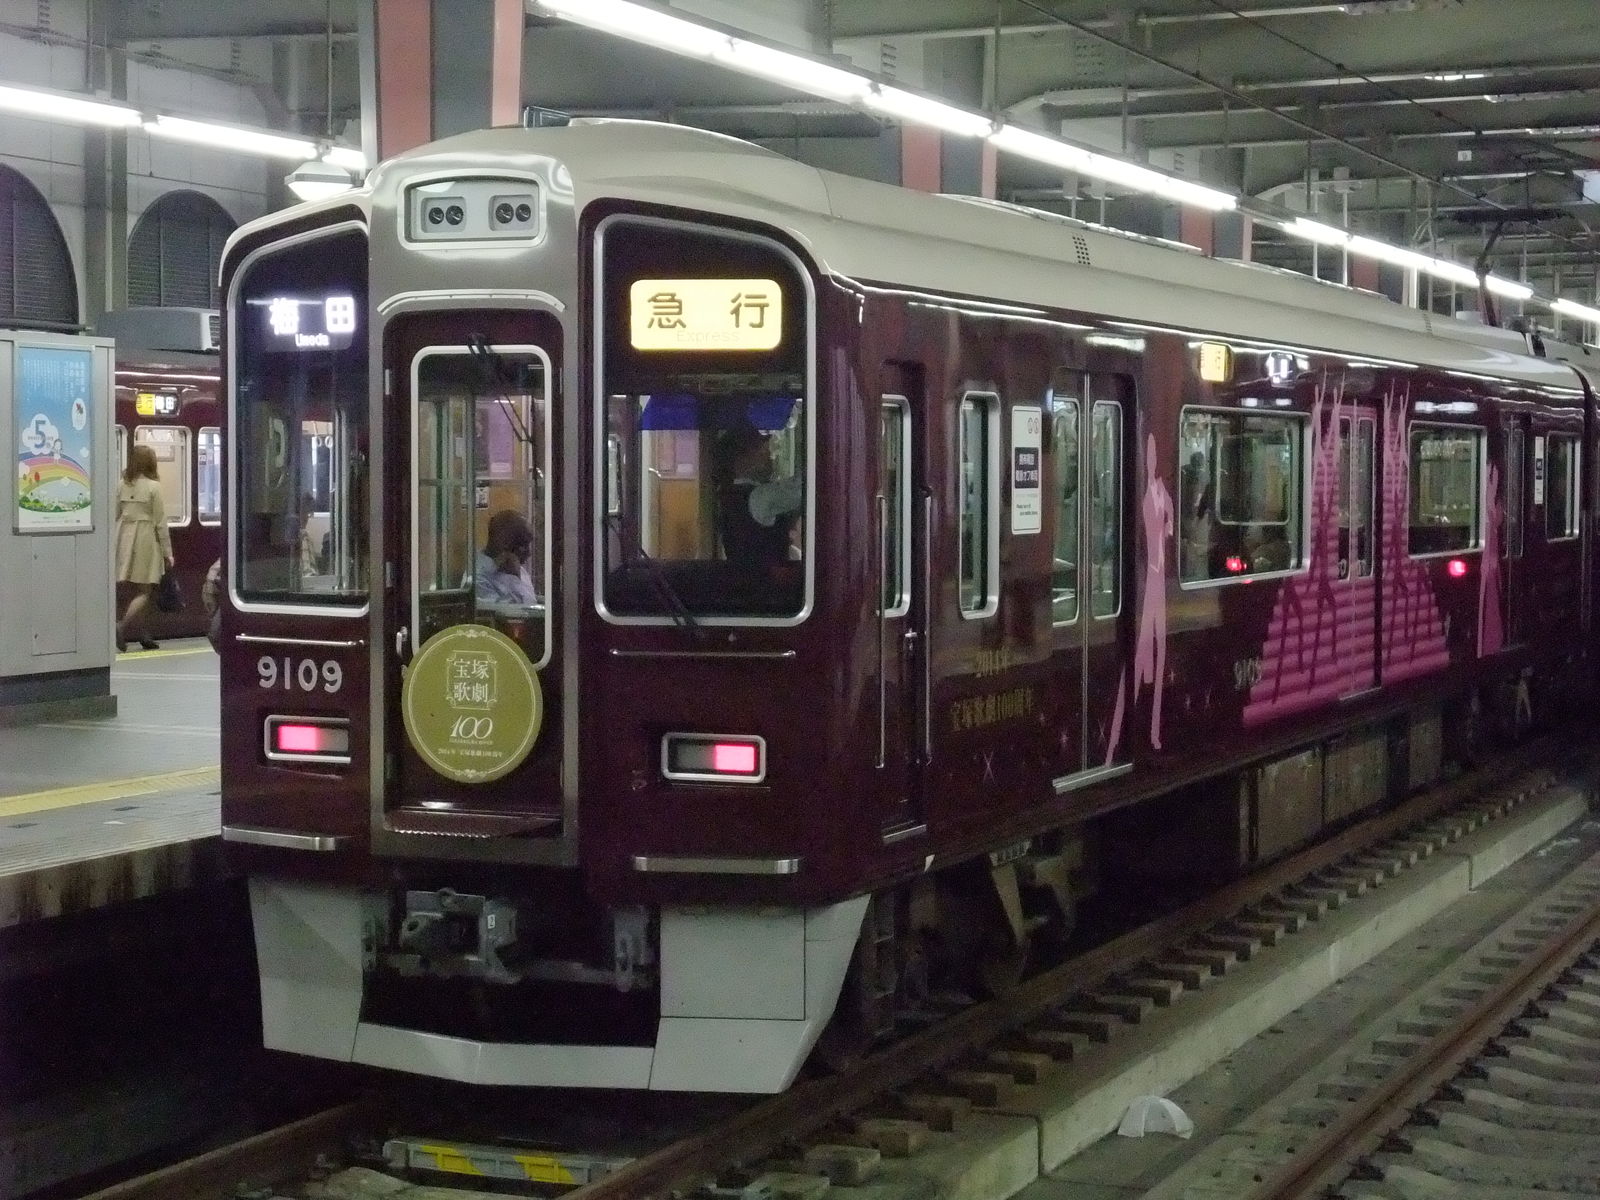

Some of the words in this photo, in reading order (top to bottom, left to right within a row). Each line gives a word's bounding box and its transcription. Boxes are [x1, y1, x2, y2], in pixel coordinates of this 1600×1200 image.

[647, 292, 770, 329] 急行
[676, 329, 741, 344] Express
[33, 419, 47, 449] 5
[257, 655, 343, 694] 9109
[453, 658, 490, 680] 宝塚
[452, 682, 489, 703] 歌劇
[449, 714, 494, 740] 100
